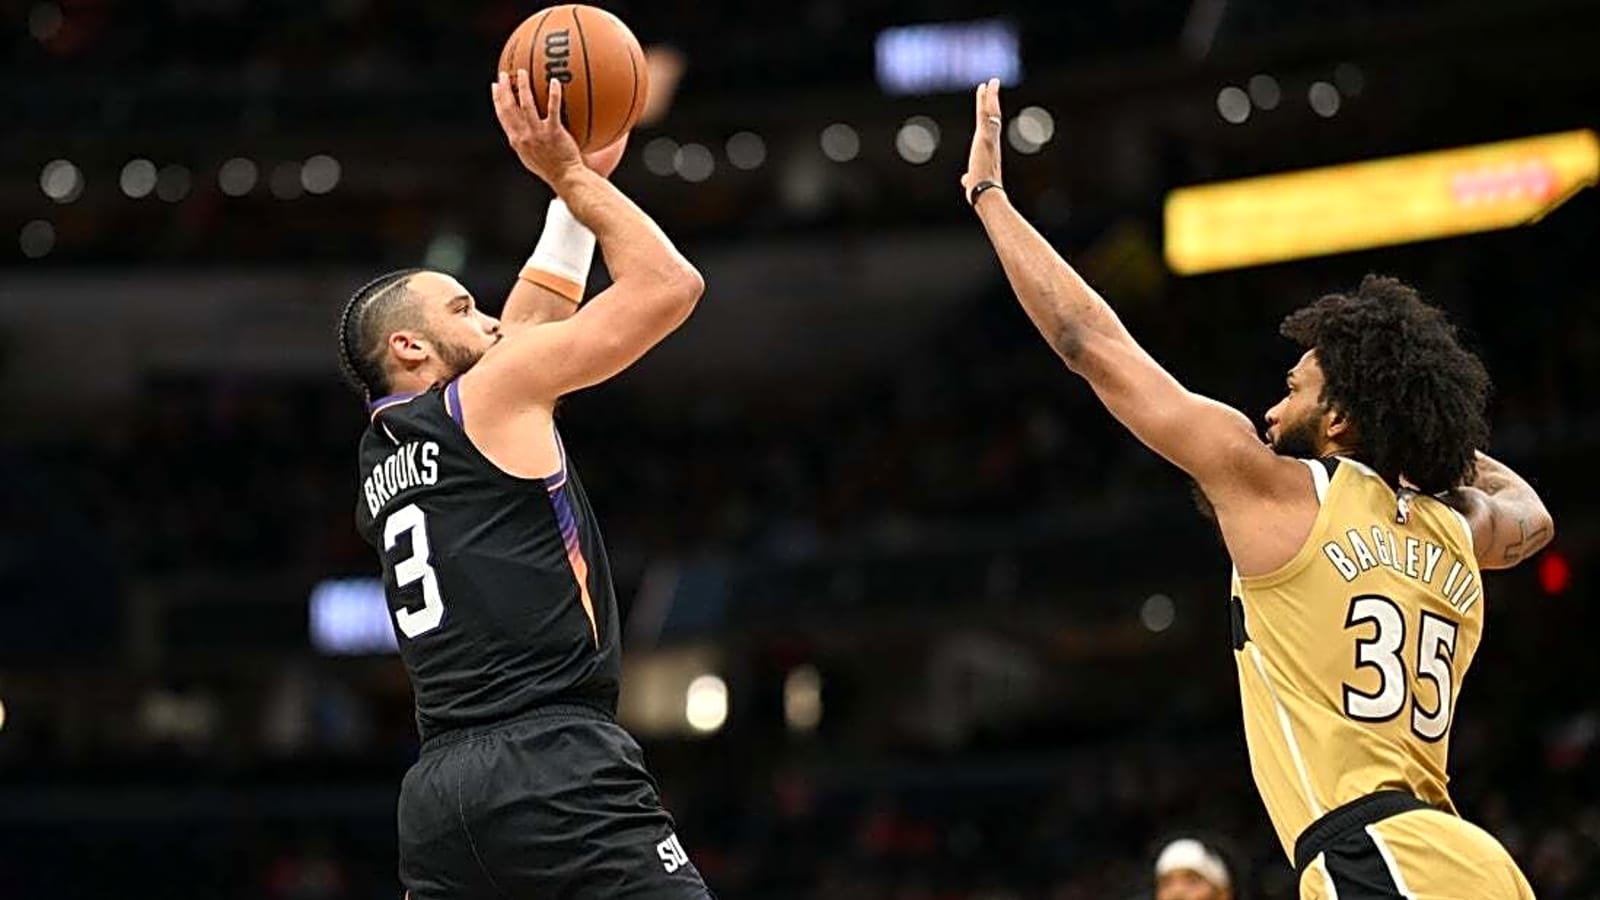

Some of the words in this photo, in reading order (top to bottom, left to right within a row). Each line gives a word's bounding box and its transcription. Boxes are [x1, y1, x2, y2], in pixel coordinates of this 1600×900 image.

[364, 441, 439, 519] BROOKS
[384, 503, 445, 639] 3
[1323, 526, 1446, 583] BAGLEY
[1442, 561, 1481, 616] III
[1342, 594, 1459, 743] 35
